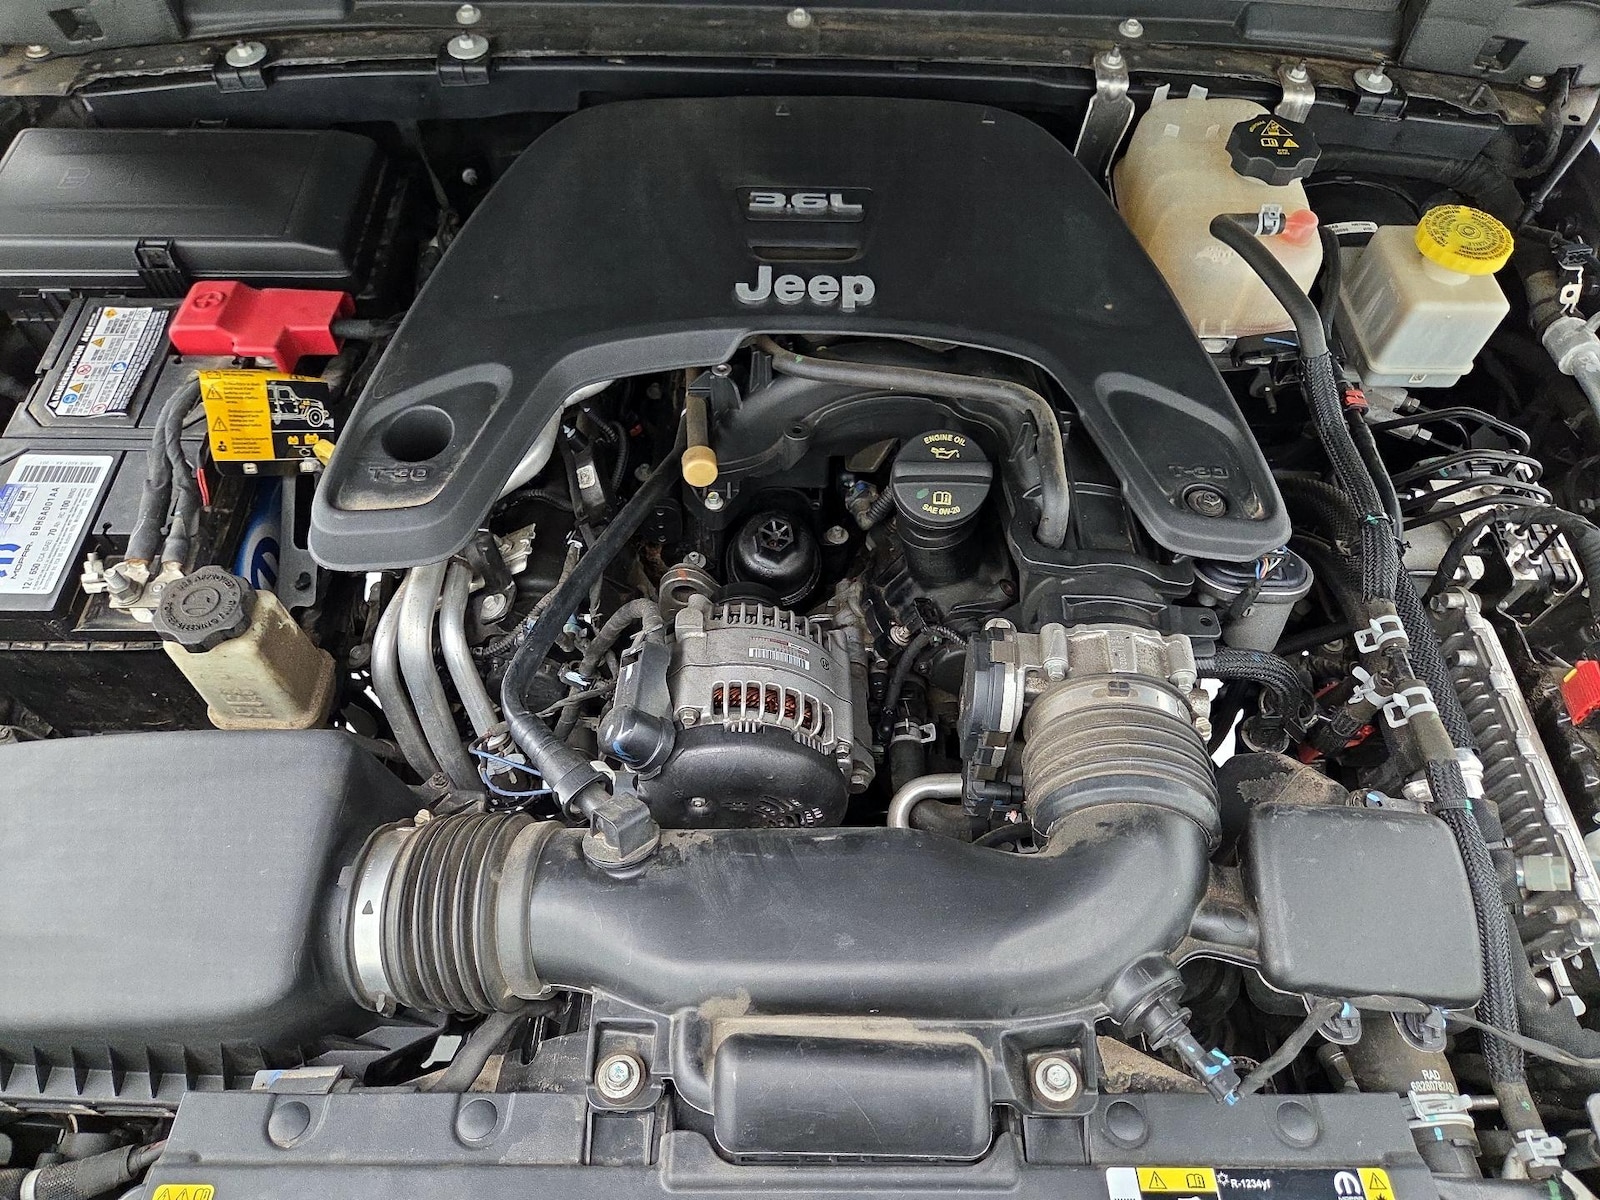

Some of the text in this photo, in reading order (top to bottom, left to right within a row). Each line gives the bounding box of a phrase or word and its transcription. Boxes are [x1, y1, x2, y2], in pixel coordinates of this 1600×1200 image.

[749, 192, 863, 213] 3.6L
[734, 265, 876, 313] Jeep
[923, 433, 966, 447] ENGINE OIL
[922, 503, 961, 515] SAE 0W-20
[29, 563, 41, 575] 650
[48, 528, 57, 537] 70
[60, 499, 71, 511] 100
[10, 542, 33, 580] MOPAR
[1421, 1069, 1441, 1081] RAD
